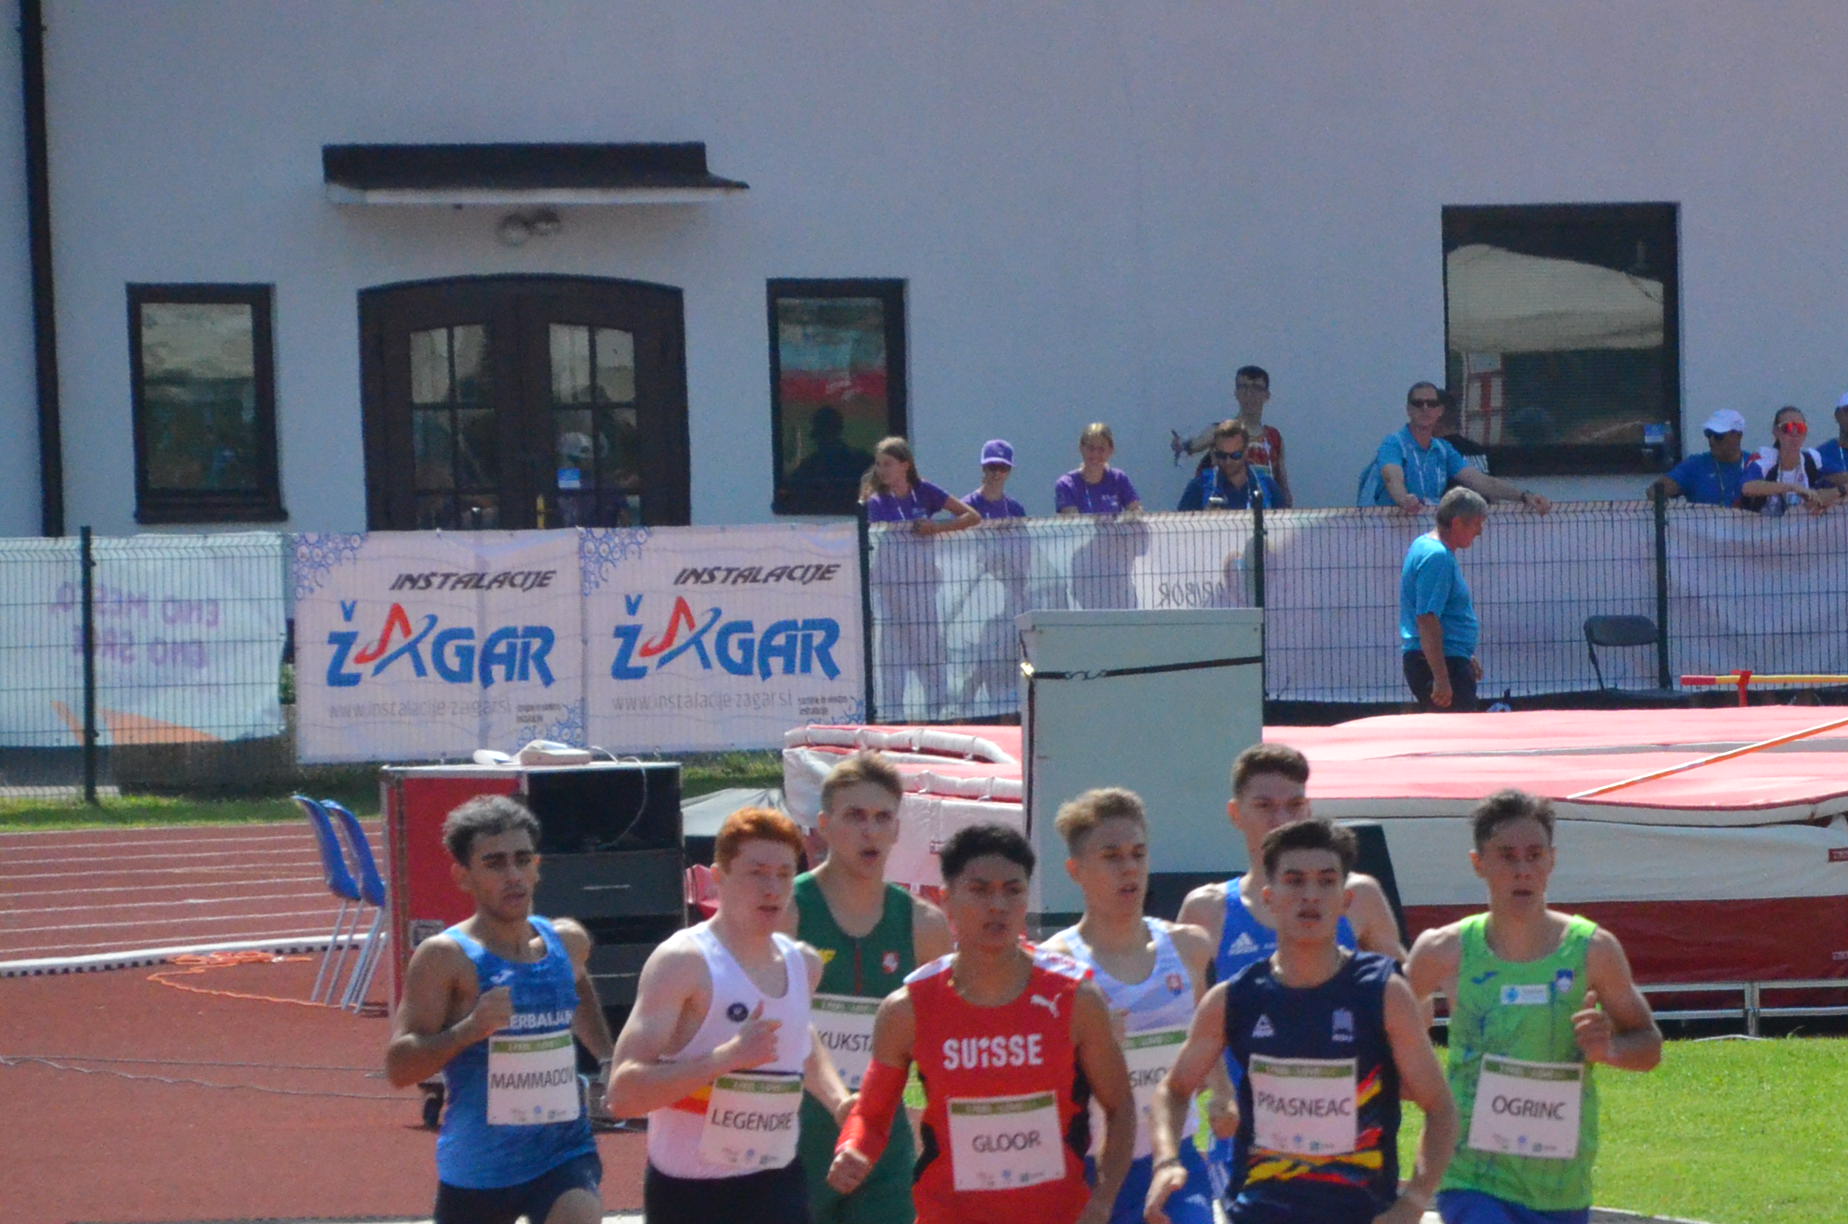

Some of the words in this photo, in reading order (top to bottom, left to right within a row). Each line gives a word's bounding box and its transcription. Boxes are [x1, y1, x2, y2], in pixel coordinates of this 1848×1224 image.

[389, 570, 556, 591] INSTALACIJE
[674, 564, 841, 585] INSTALACIJE
[326, 600, 556, 689] ŽAGAR
[610, 594, 841, 681] ŽAGAR
[509, 1010, 573, 1030] ERBAIJAN
[1129, 1066, 1168, 1088] SIKO
[1258, 1091, 1351, 1118] PRASNEAC
[1491, 1095, 1566, 1121] OGRINC
[710, 1108, 794, 1132] LEGENDRE
[972, 1130, 1041, 1153] GLOOR
